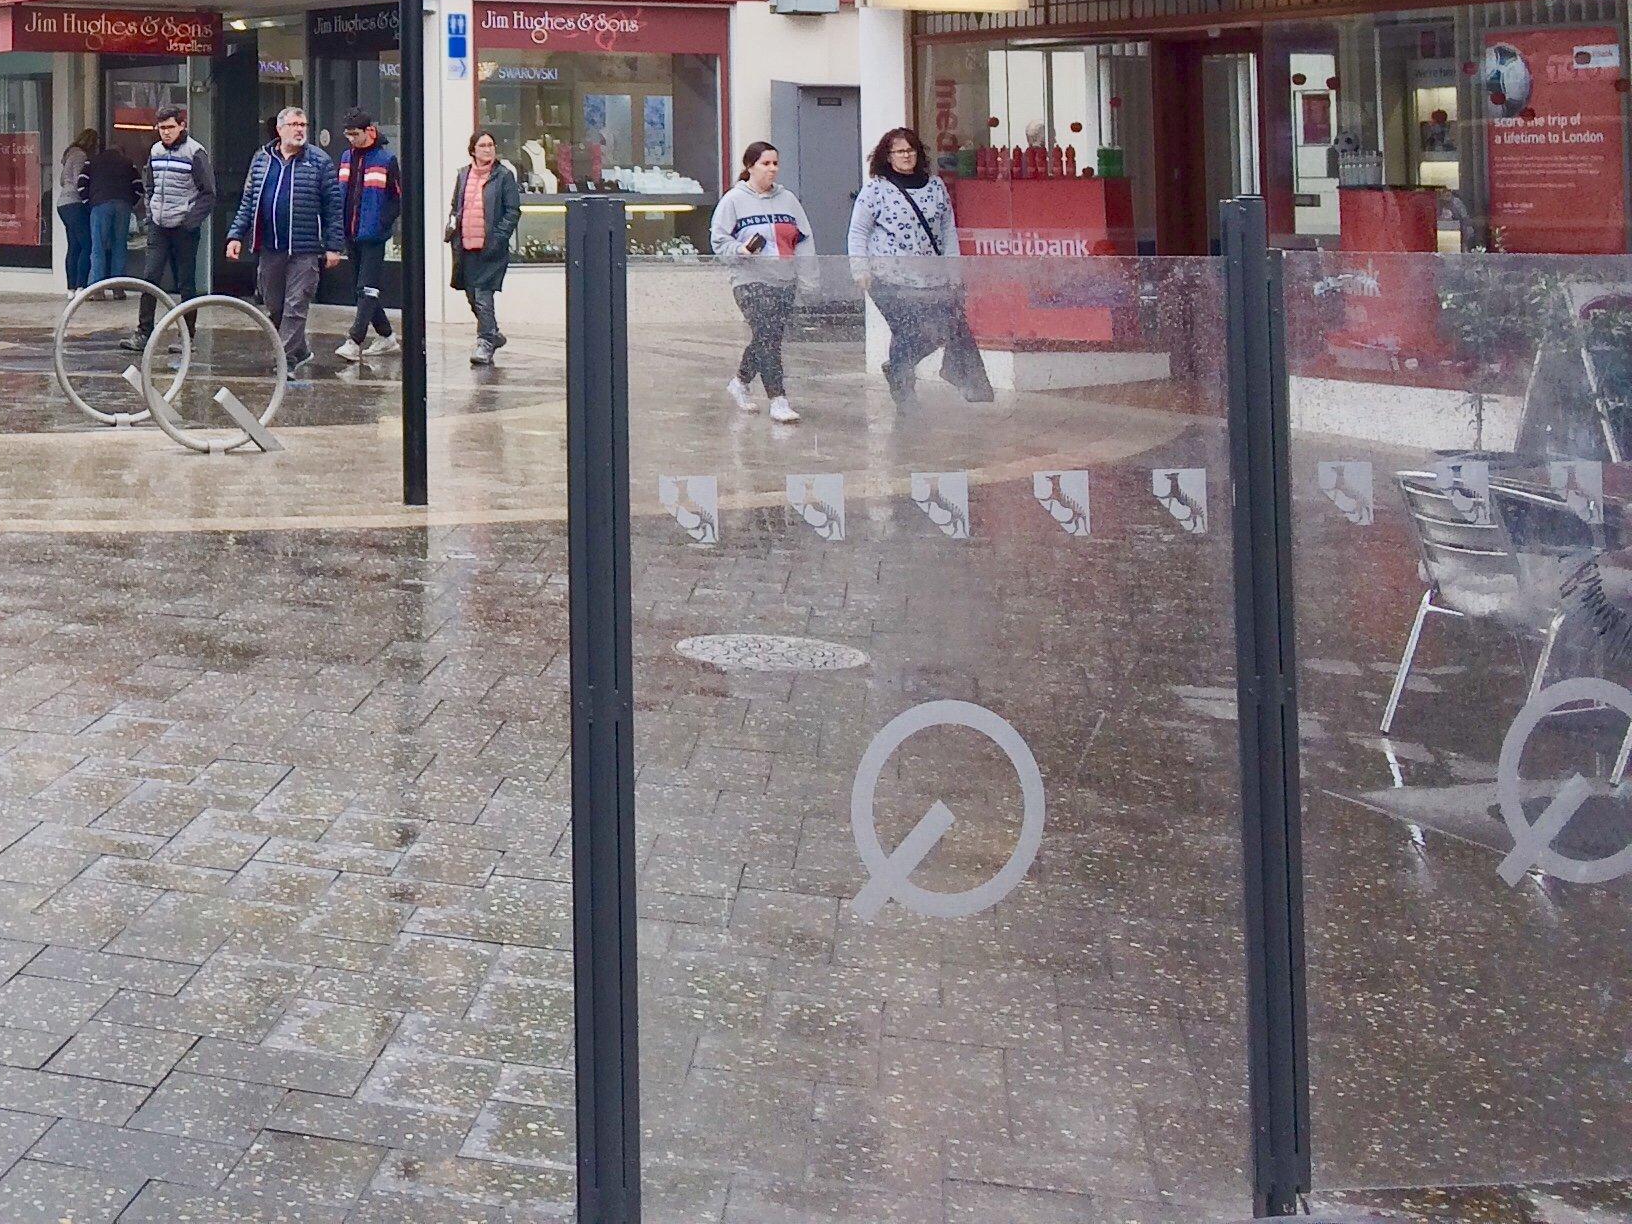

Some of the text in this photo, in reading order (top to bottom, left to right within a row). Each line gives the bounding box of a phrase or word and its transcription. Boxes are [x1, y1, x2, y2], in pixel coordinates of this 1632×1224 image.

[24, 12, 214, 51] Jim Hughes & Sons
[313, 17, 332, 35] Jim
[333, 13, 376, 44] Hughes
[481, 10, 639, 44] Jim Hughes & Sons
[165, 38, 213, 54] Jewellers
[498, 67, 559, 80] SWAROVSKI
[1494, 114, 1524, 128] score
[1547, 114, 1569, 129] trip
[1570, 112, 1582, 126] of
[1494, 130, 1604, 145] a lifetime to London
[974, 231, 1091, 258] medibank
